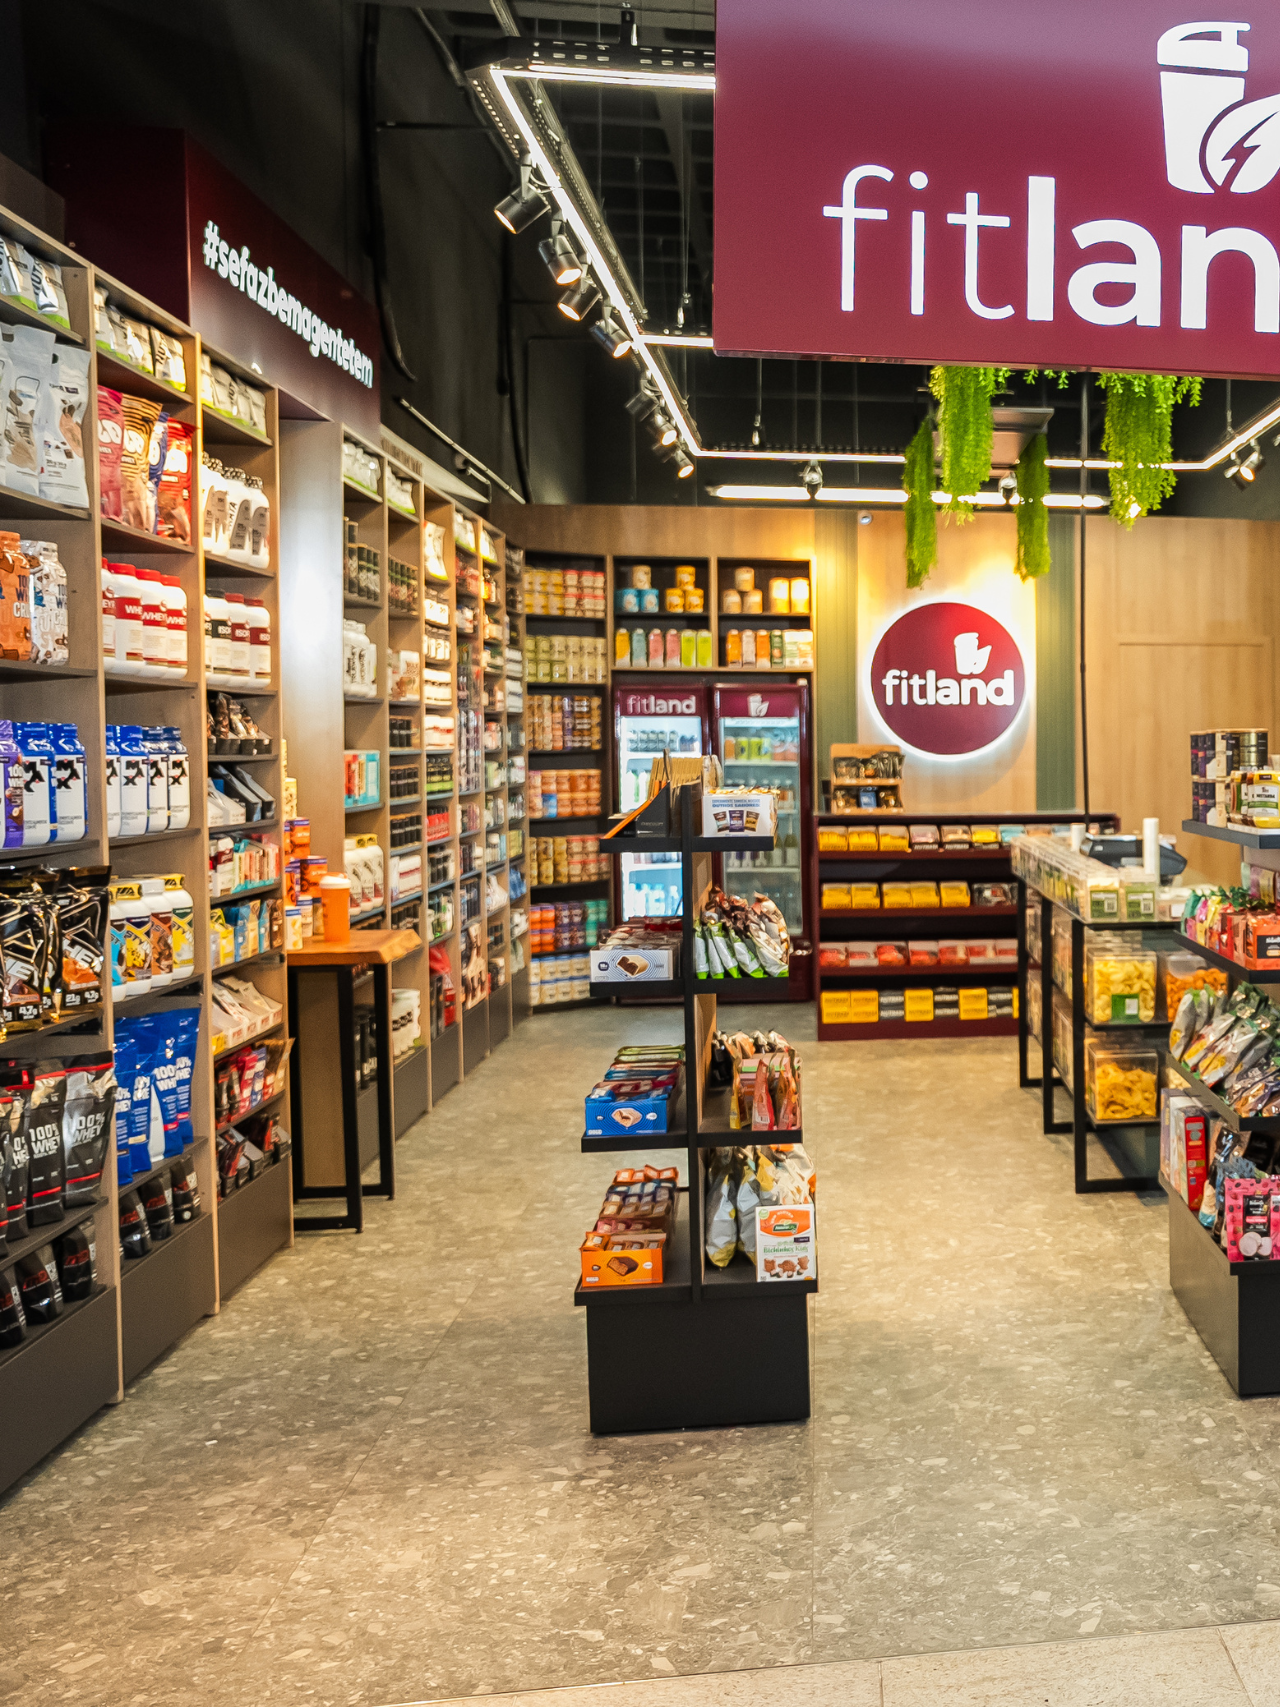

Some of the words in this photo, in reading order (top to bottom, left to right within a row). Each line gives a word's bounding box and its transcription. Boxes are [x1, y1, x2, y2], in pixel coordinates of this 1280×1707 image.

[203, 220, 374, 389] #sefazbemagentetem
[626, 694, 696, 714] fitland
[881, 668, 1015, 707] fitland
